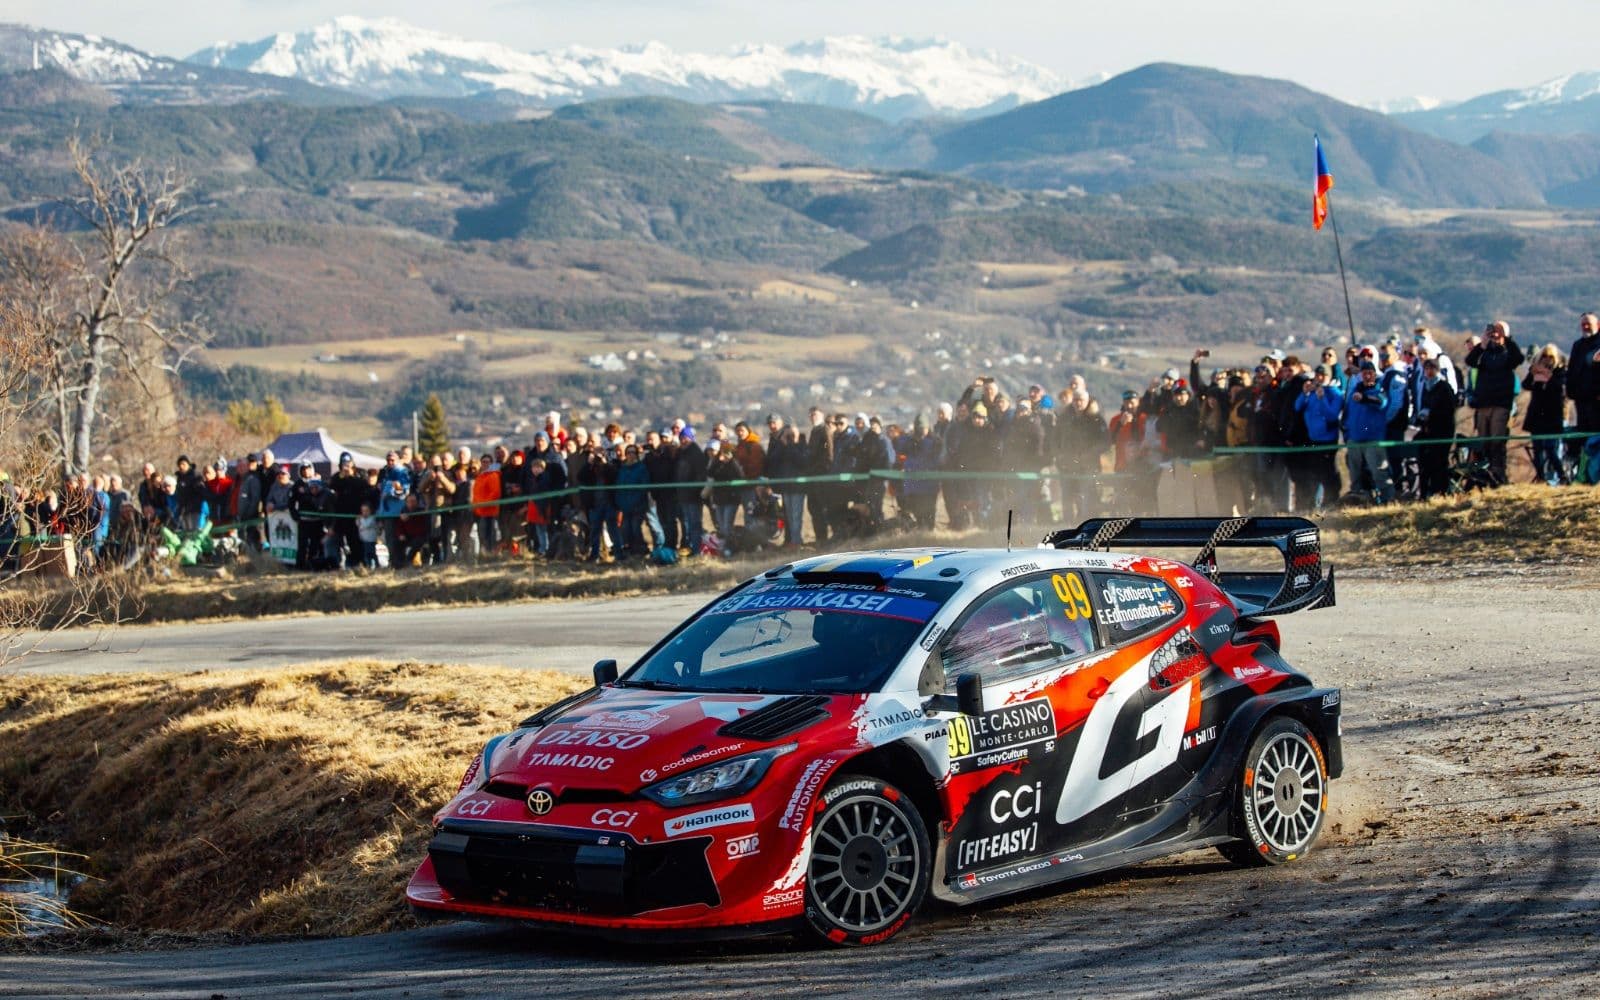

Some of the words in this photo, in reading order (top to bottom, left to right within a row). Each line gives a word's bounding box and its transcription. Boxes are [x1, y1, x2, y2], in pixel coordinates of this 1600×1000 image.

[1001, 562, 1041, 577] PROTERIAL
[1053, 572, 1093, 621] 99
[870, 708, 922, 729] TAMADIC
[970, 716, 989, 736] LE
[990, 703, 1050, 732] CASINO
[537, 730, 650, 750] DENSO
[924, 728, 948, 741] PIAA
[948, 717, 970, 758] 99
[528, 753, 615, 771] TAMADIC
[661, 742, 744, 772] codebeamer
[977, 748, 1029, 766] SafetyCulture
[778, 758, 823, 829] Panasonic
[792, 758, 837, 832] AUTOMOTIVE
[726, 837, 760, 856] OMP
